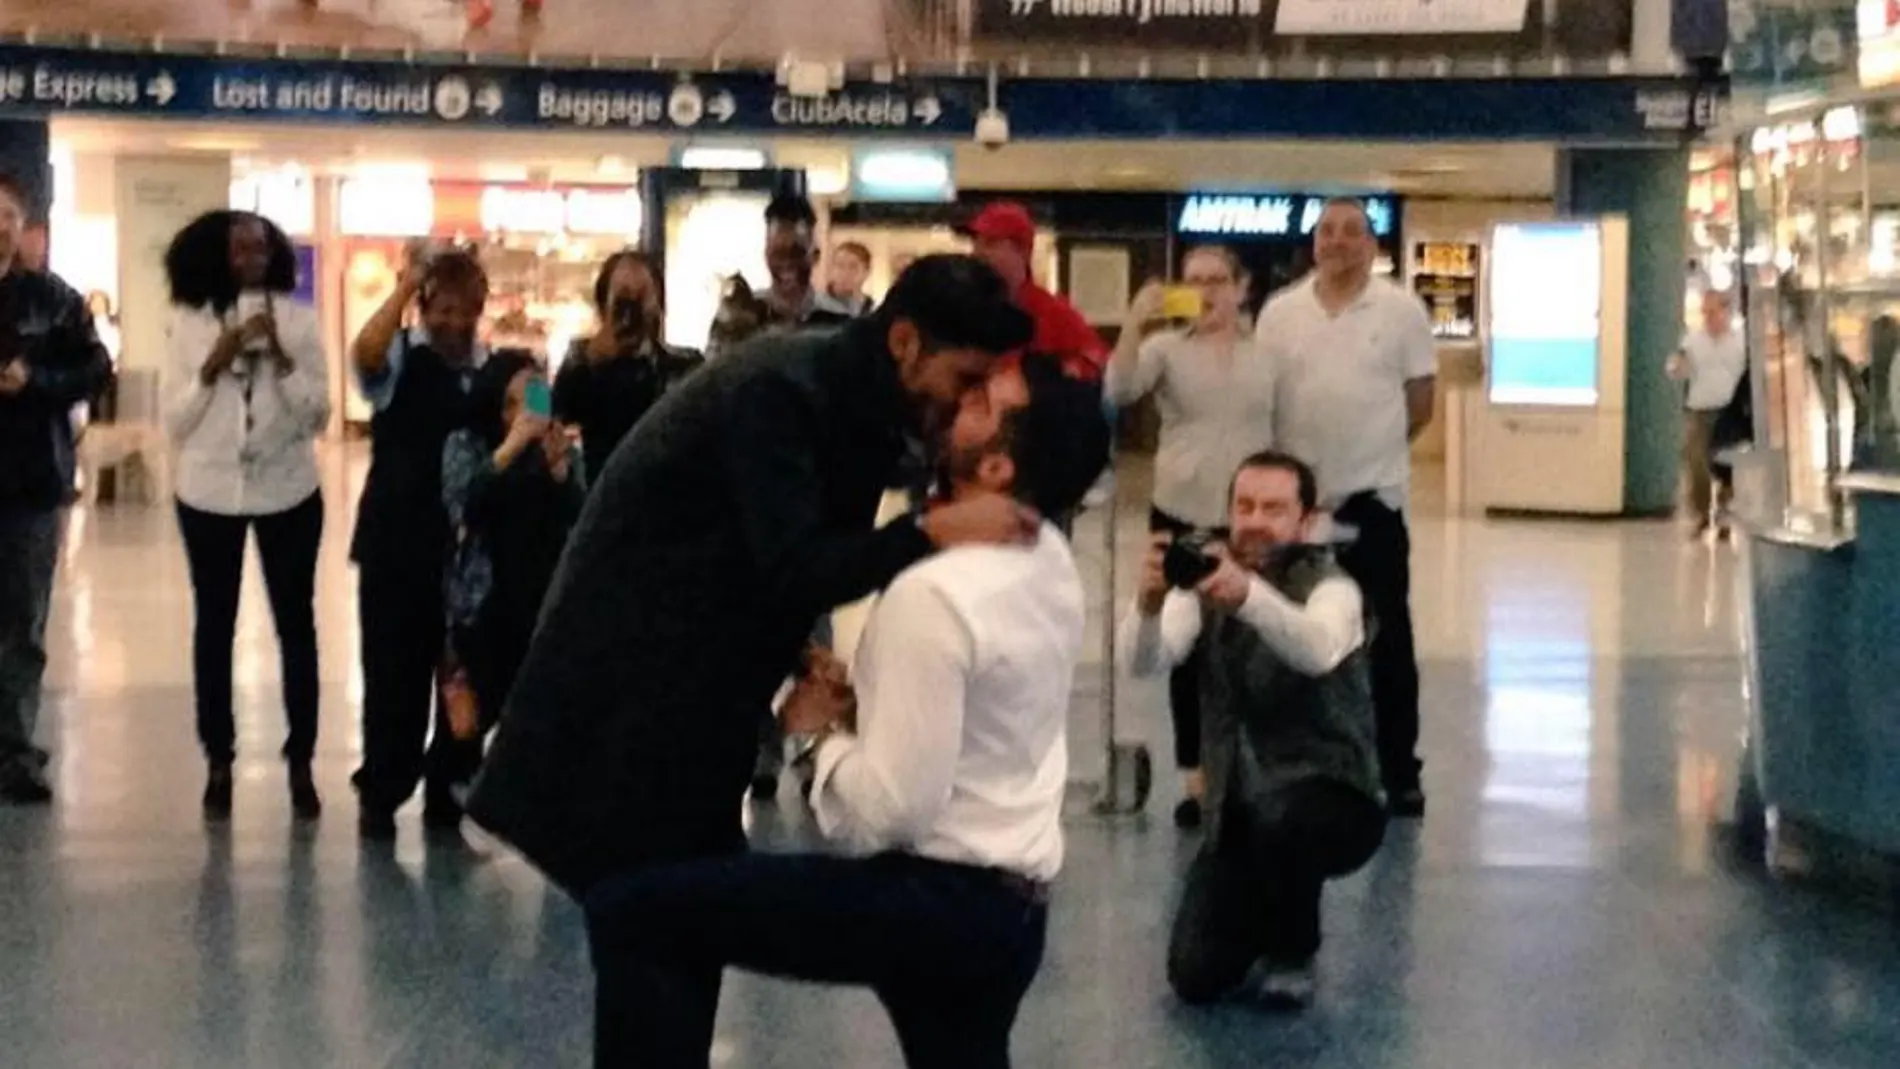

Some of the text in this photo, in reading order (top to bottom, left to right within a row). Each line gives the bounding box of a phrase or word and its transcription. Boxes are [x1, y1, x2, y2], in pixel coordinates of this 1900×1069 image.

[34, 66, 138, 107] Express
[213, 76, 430, 113] Lost and Found
[539, 83, 662, 126] Baggage
[1178, 196, 1294, 234] AMTRAK
